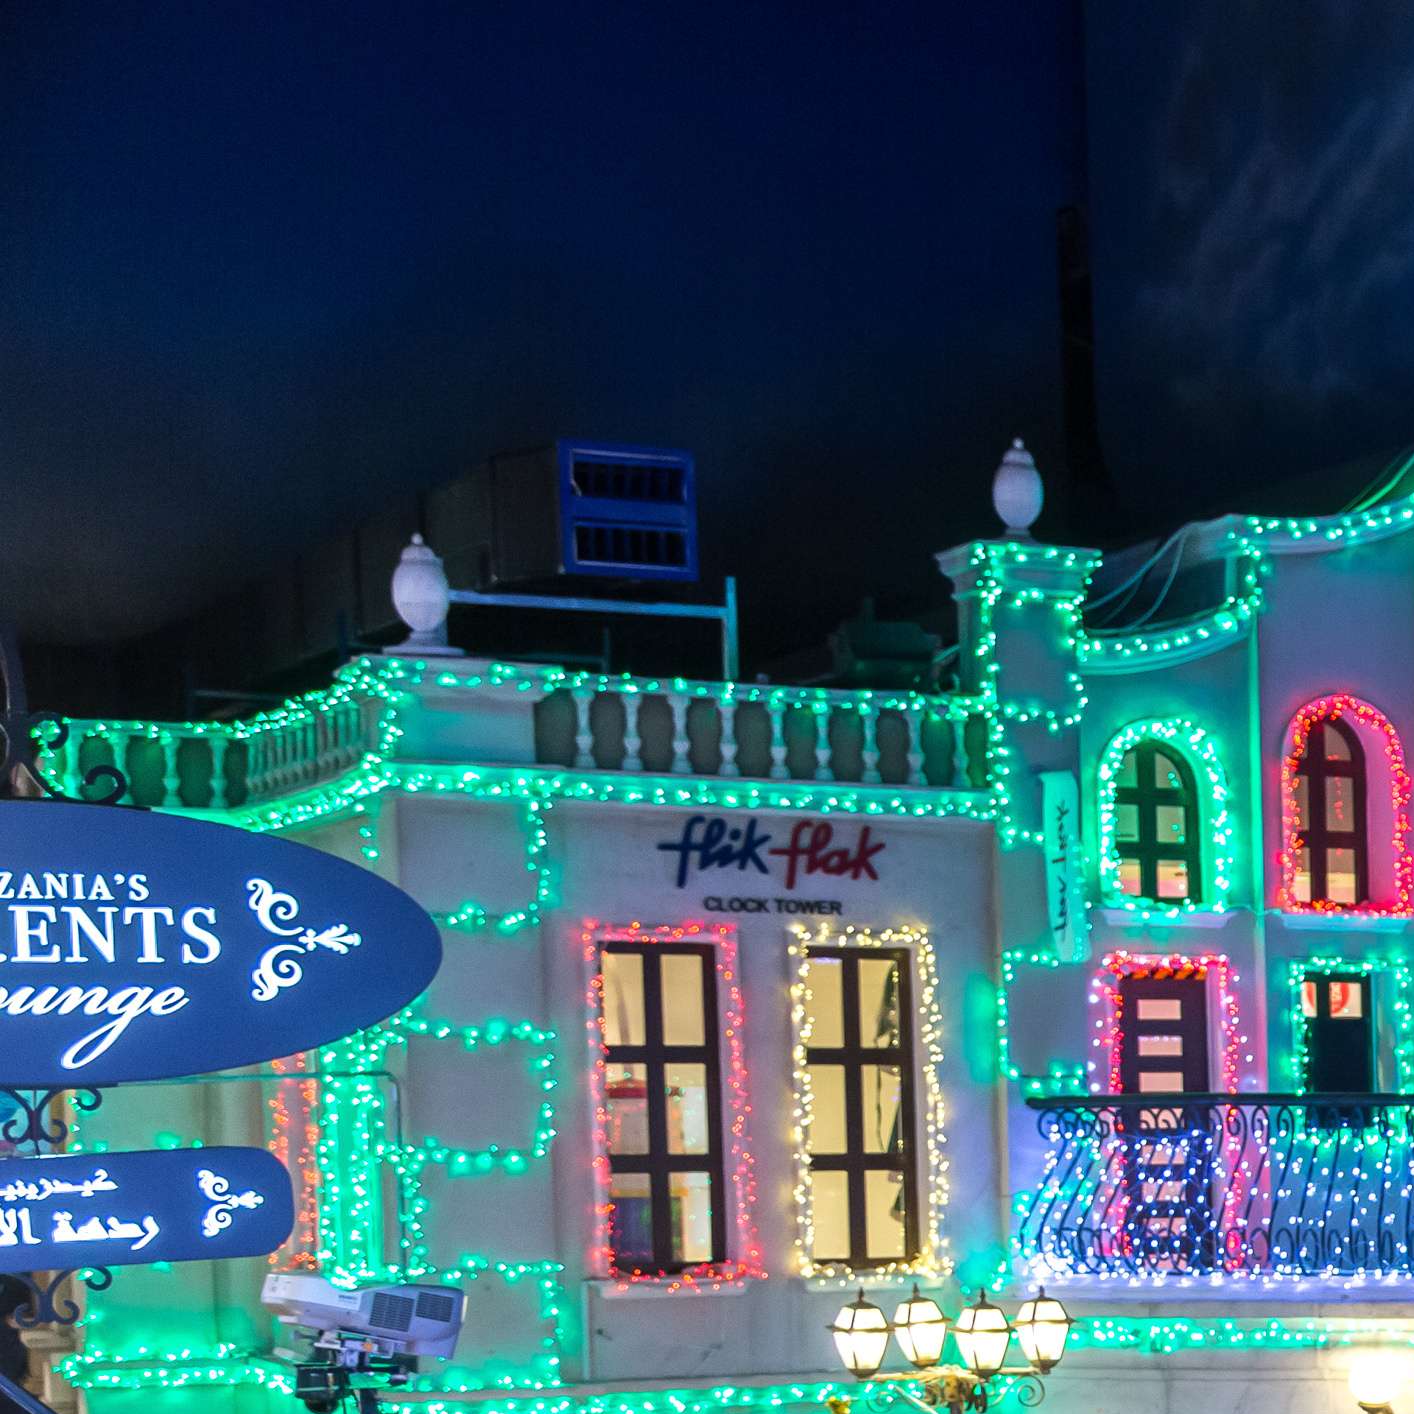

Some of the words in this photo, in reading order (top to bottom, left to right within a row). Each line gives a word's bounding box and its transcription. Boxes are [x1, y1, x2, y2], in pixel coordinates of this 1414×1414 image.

[657, 815, 772, 889] flik
[768, 819, 887, 890] flak
[0, 905, 221, 963] ENTS
[703, 897, 770, 913] CLOCK
[775, 898, 843, 916] TOWER
